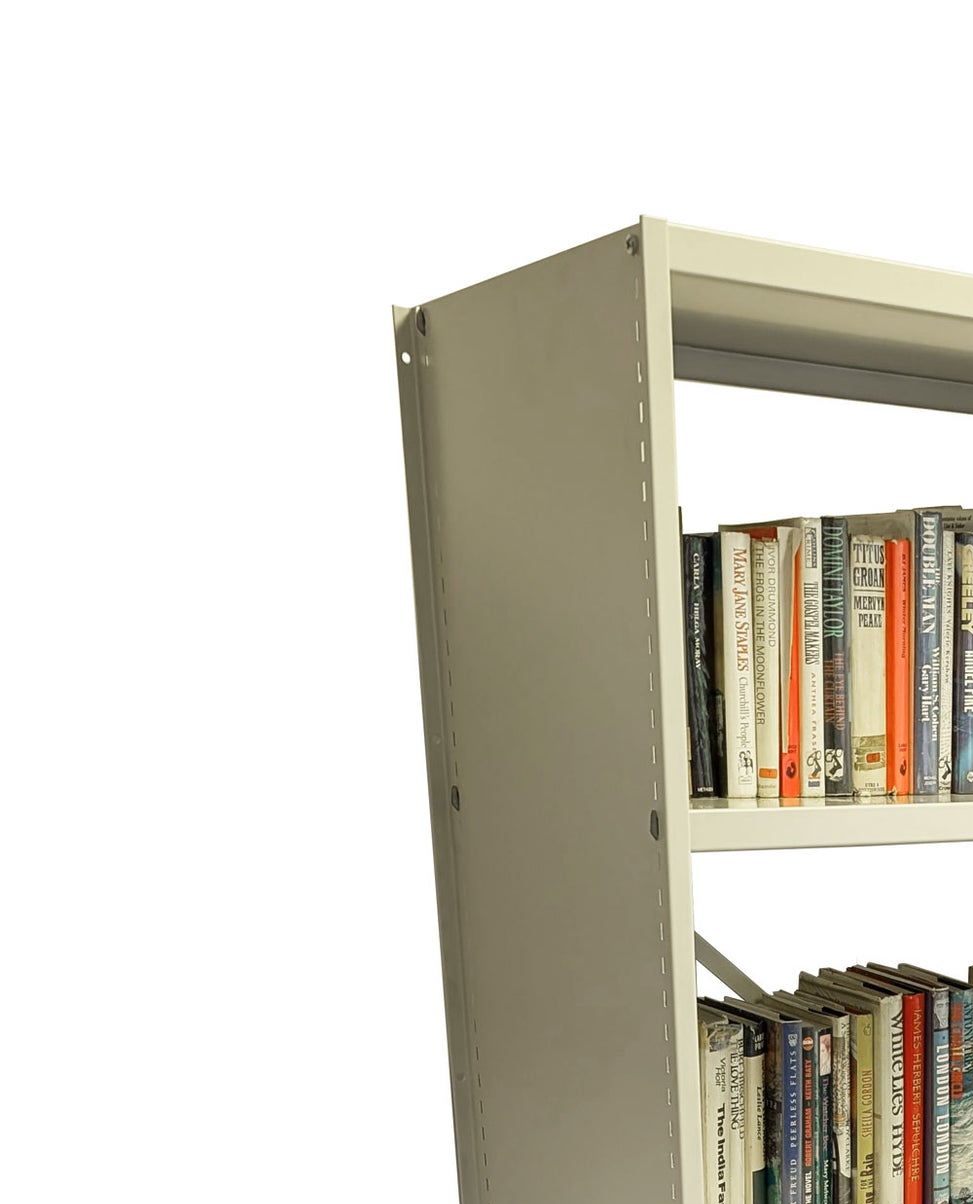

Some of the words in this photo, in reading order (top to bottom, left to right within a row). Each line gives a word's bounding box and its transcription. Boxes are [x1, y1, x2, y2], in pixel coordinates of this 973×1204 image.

[733, 548, 748, 585] MARY
[756, 547, 765, 569] THE
[822, 526, 844, 582] DOMINI
[853, 543, 885, 564] TITUS
[922, 516, 937, 590] DOUBLE
[756, 572, 765, 602] FROG
[804, 582, 817, 598] THE
[853, 568, 885, 588] GROAN
[732, 588, 747, 619] JANE
[756, 605, 765, 618] IN
[768, 578, 776, 647] DRUMMOND
[804, 599, 818, 629] GOSPEL
[823, 586, 844, 638] TAYLOR
[858, 612, 882, 629] PEAKE
[922, 595, 936, 634] MAN
[734, 621, 749, 671] STAPLES
[756, 621, 765, 642] THE
[805, 631, 820, 664] MAKERS
[694, 637, 702, 670] MORAY
[825, 659, 833, 677] THE
[835, 652, 843, 671] THE
[931, 647, 941, 692] William
[756, 645, 766, 725] MOONFLOWER
[918, 664, 931, 693] Gary
[737, 677, 750, 720] Churchill's
[825, 679, 834, 723] CURTAIN
[835, 694, 846, 730] BEHIND
[920, 696, 932, 722] Hart
[738, 722, 750, 748] People
[931, 704, 940, 741] Cohen
[912, 1009, 922, 1049] JAMES
[964, 1002, 973, 1043] ANTONY
[889, 1013, 904, 1071] White
[964, 1045, 973, 1073] TREW
[715, 1067, 723, 1086] Holt
[719, 1057, 727, 1092] Victoria
[730, 1065, 739, 1093] LOVE
[789, 1050, 798, 1086] FLATS
[911, 1053, 921, 1105] HERBERT
[936, 1044, 949, 1106] LONDON
[861, 1069, 872, 1106] GORDON
[891, 1075, 904, 1115] Lies
[718, 1102, 727, 1136] The
[730, 1096, 740, 1130] THING
[789, 1092, 797, 1148] PEERLESS
[804, 1107, 812, 1140] GRAHAM
[862, 1108, 872, 1138] SHEILA
[718, 1139, 727, 1180] India
[891, 1124, 902, 1177] HYDE
[911, 1113, 921, 1182] SEPULCHRE
[935, 1114, 949, 1174] LONDON
[789, 1159, 797, 1195] FREUD
[804, 1171, 812, 1193] NOVEL
[822, 1159, 830, 1178] Mary
